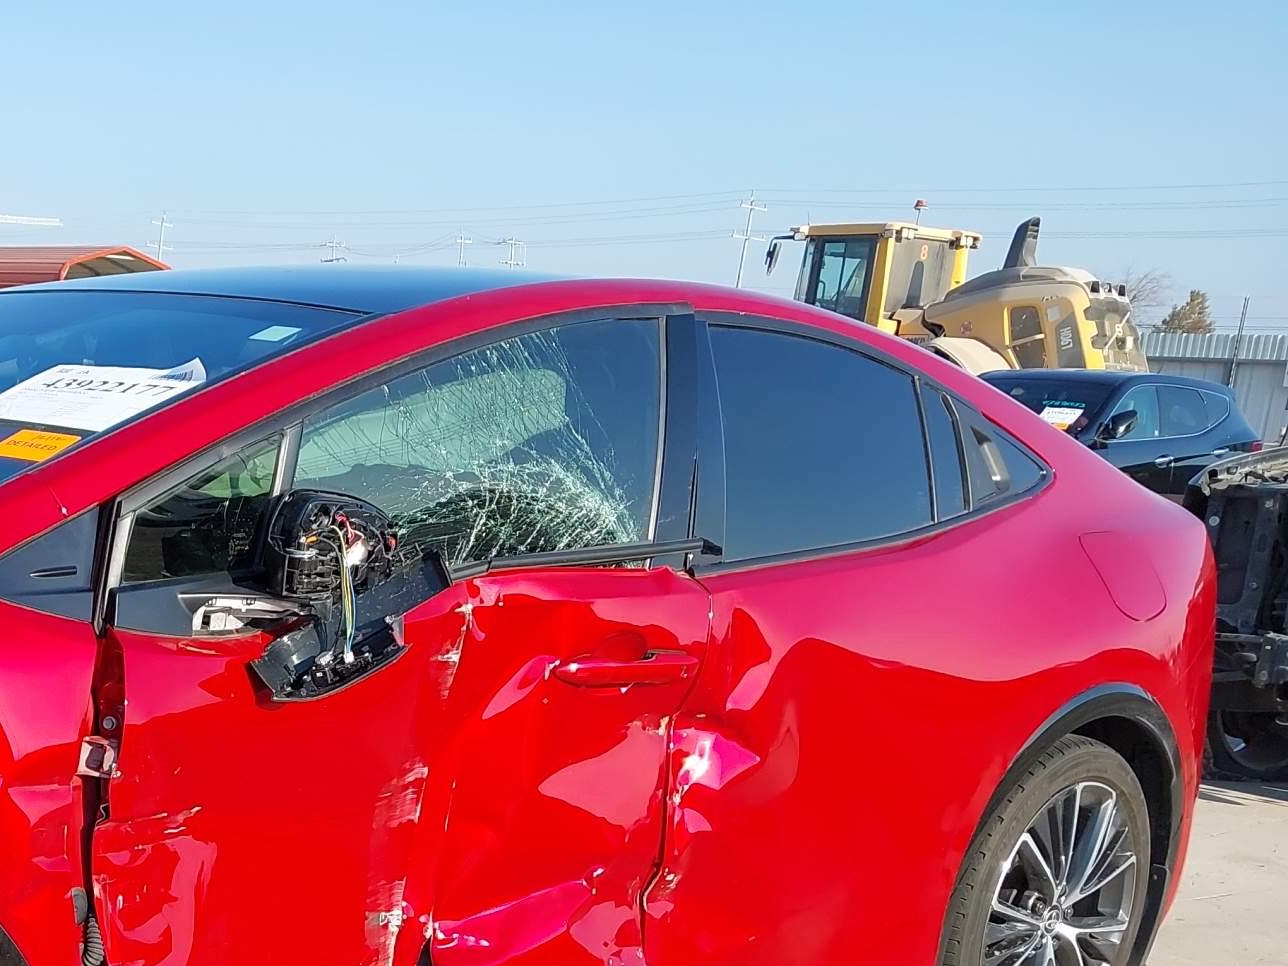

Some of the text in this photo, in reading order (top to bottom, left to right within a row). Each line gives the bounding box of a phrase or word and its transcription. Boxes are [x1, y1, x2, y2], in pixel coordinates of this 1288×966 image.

[920, 244, 929, 261] 8
[41, 377, 178, 397] 43922177
[6, 439, 58, 452] DETAILED
